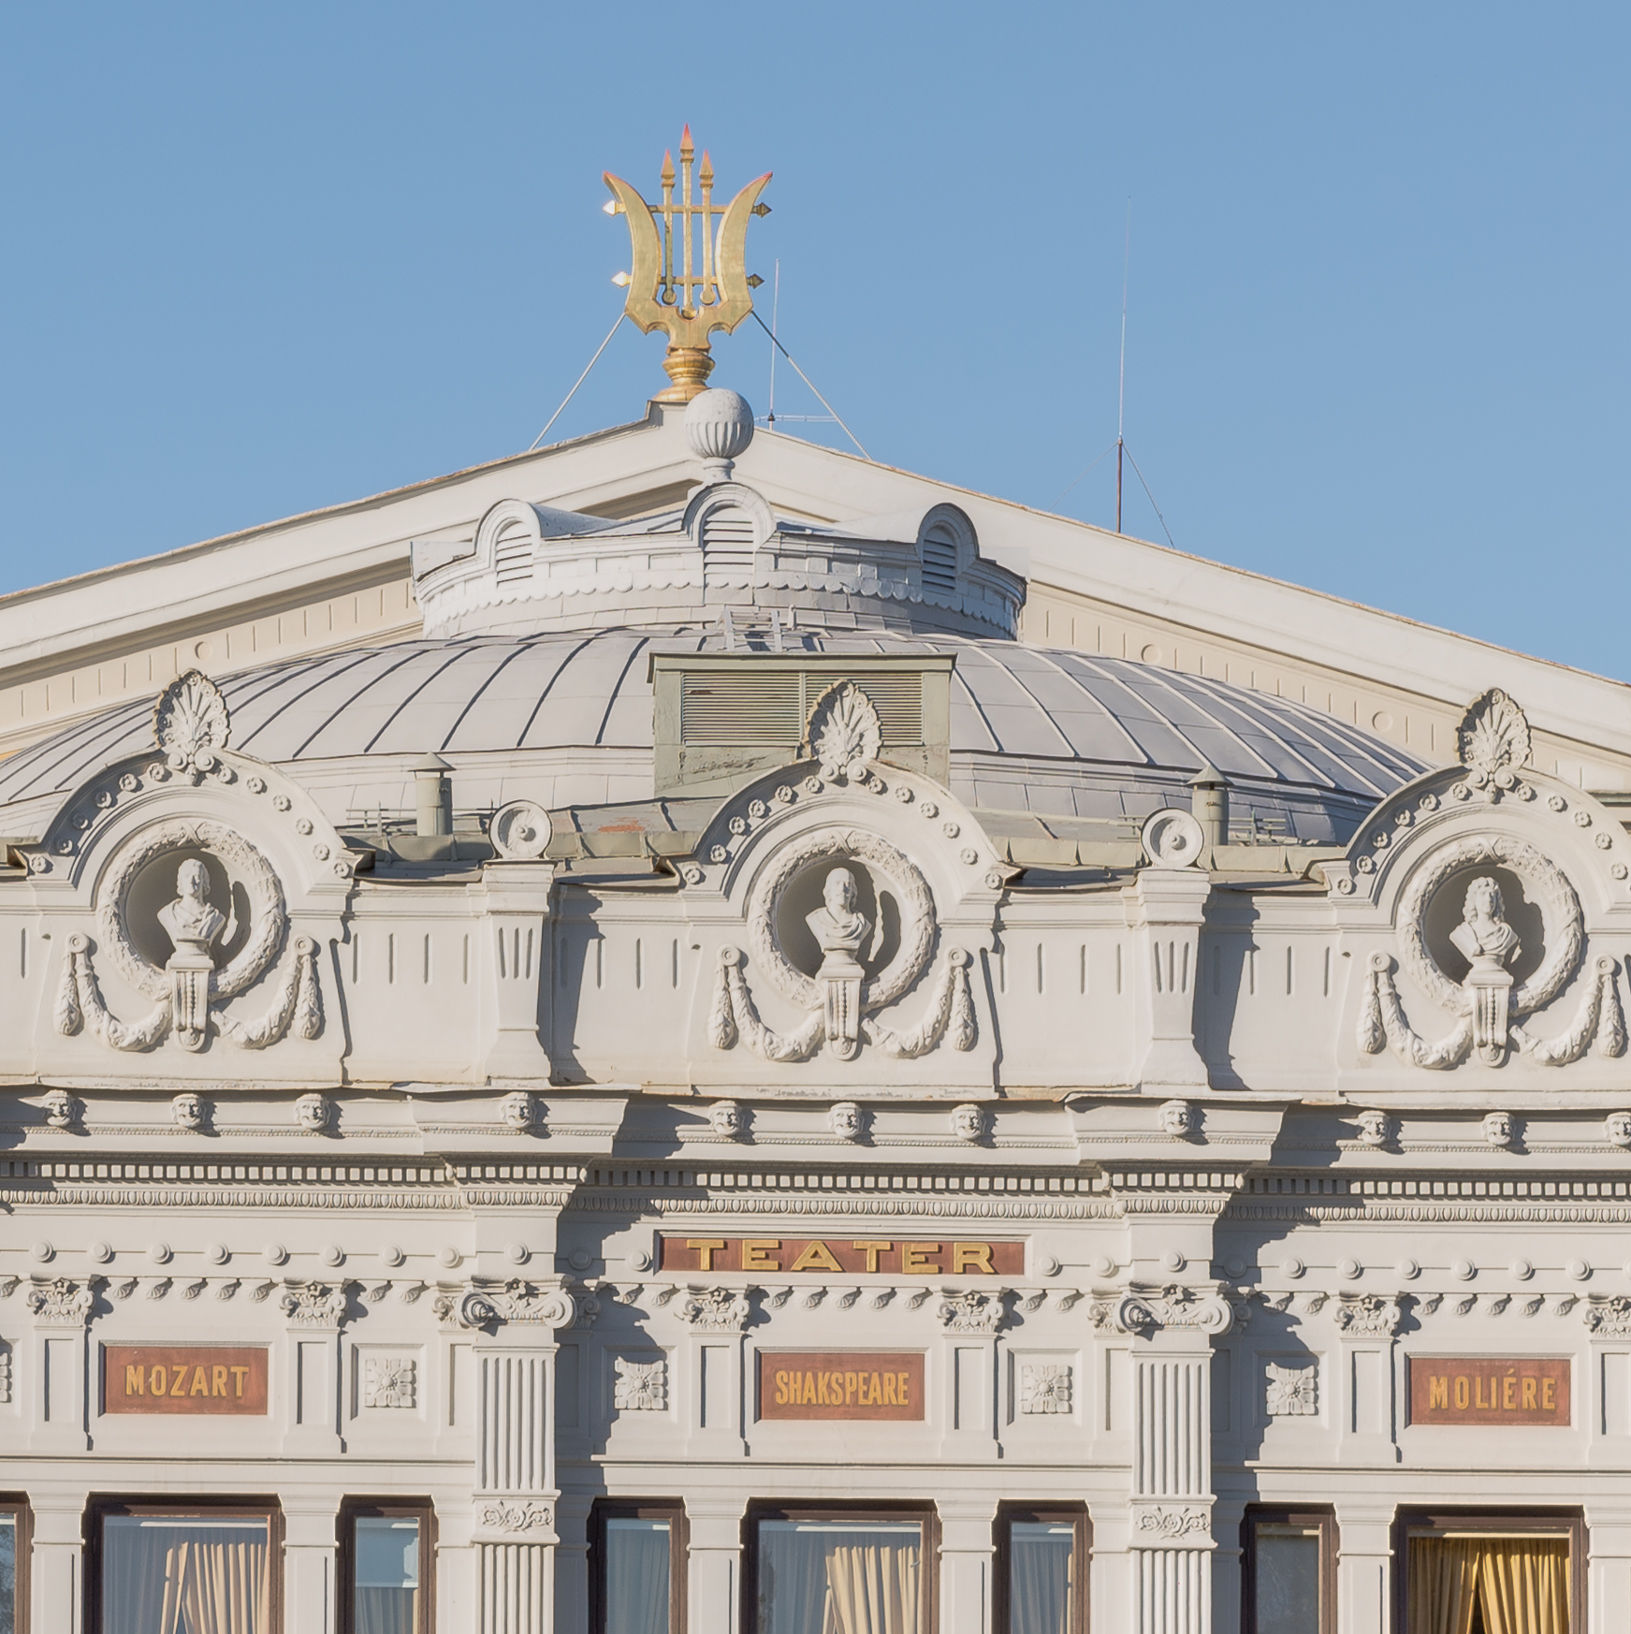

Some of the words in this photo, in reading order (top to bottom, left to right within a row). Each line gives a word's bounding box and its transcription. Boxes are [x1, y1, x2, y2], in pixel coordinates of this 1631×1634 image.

[686, 1238, 996, 1275] TEATER
[125, 1364, 249, 1397] MOZART
[775, 1369, 910, 1407] SHAKSPEARE
[1428, 1368, 1557, 1411] MOLIÉRE
